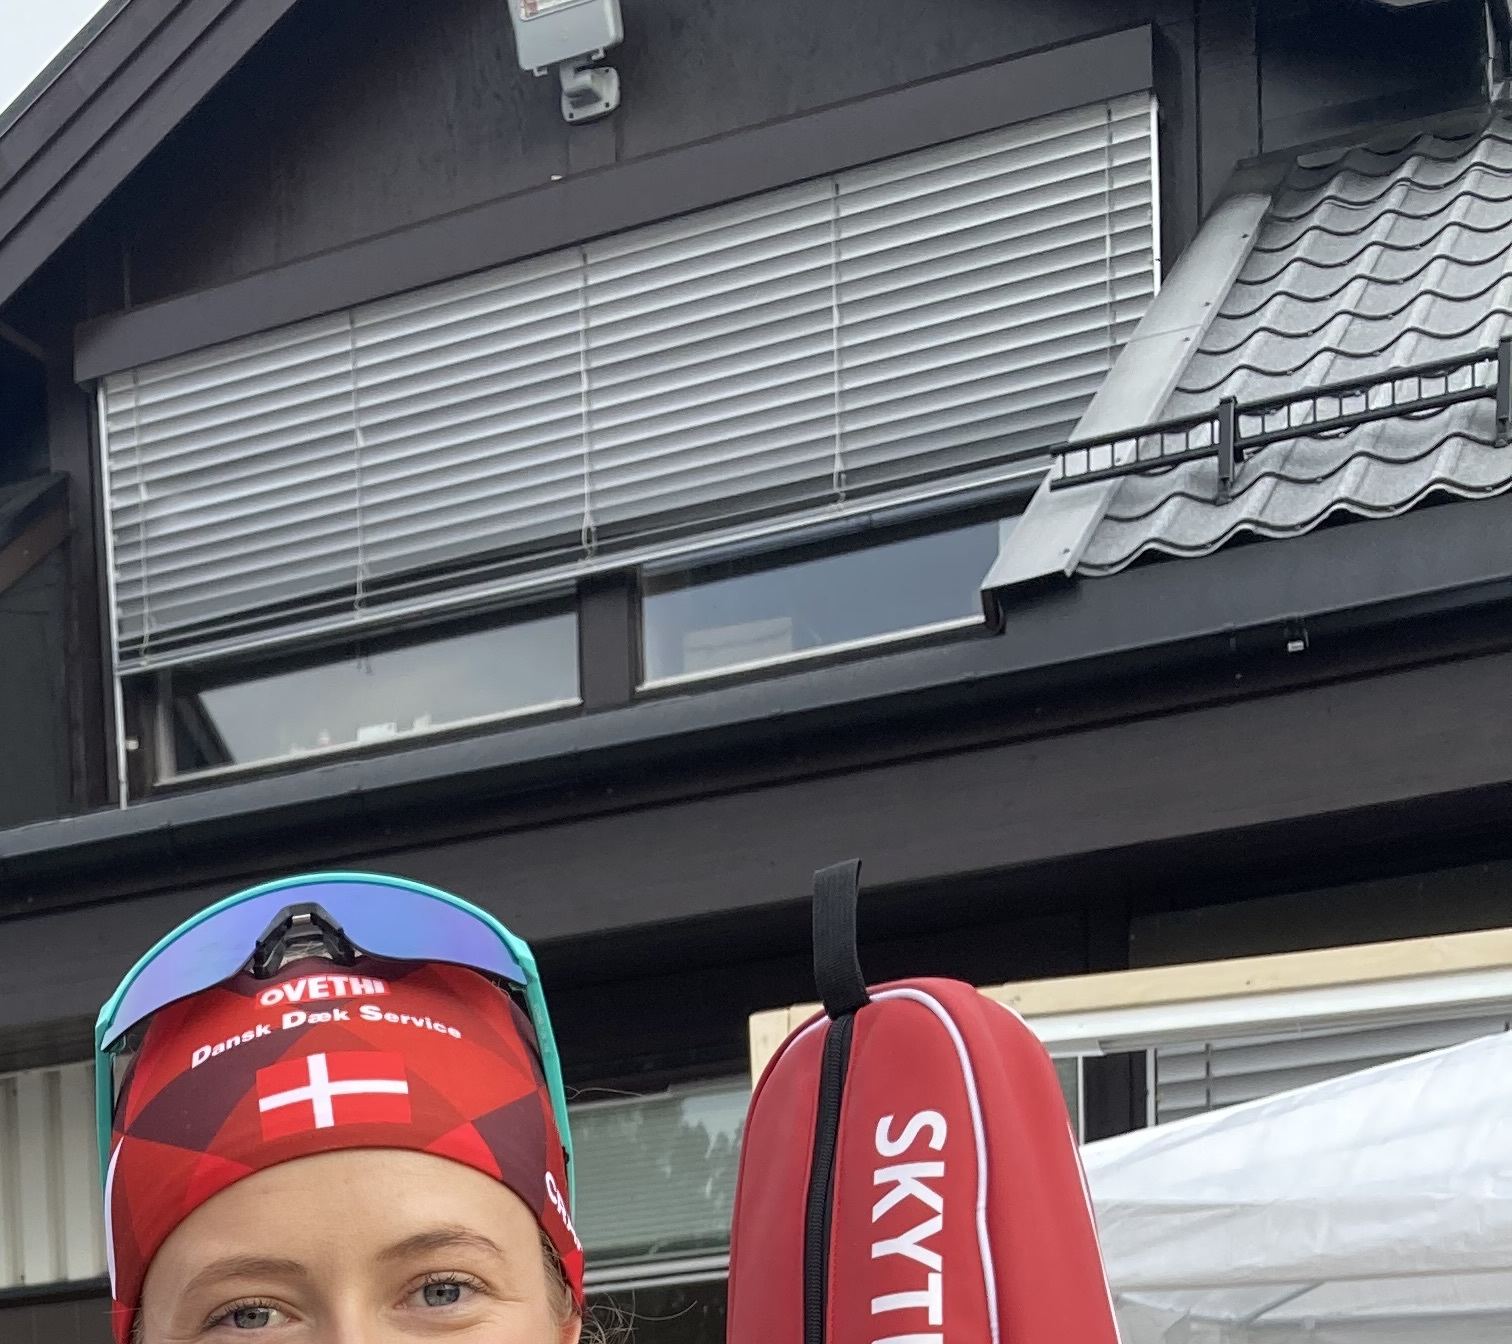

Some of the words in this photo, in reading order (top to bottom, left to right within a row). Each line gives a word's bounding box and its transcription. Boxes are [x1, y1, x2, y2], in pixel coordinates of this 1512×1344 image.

[191, 1024, 272, 1069] Dansk
[282, 1008, 350, 1031] Dæk
[359, 1004, 462, 1039] Service
